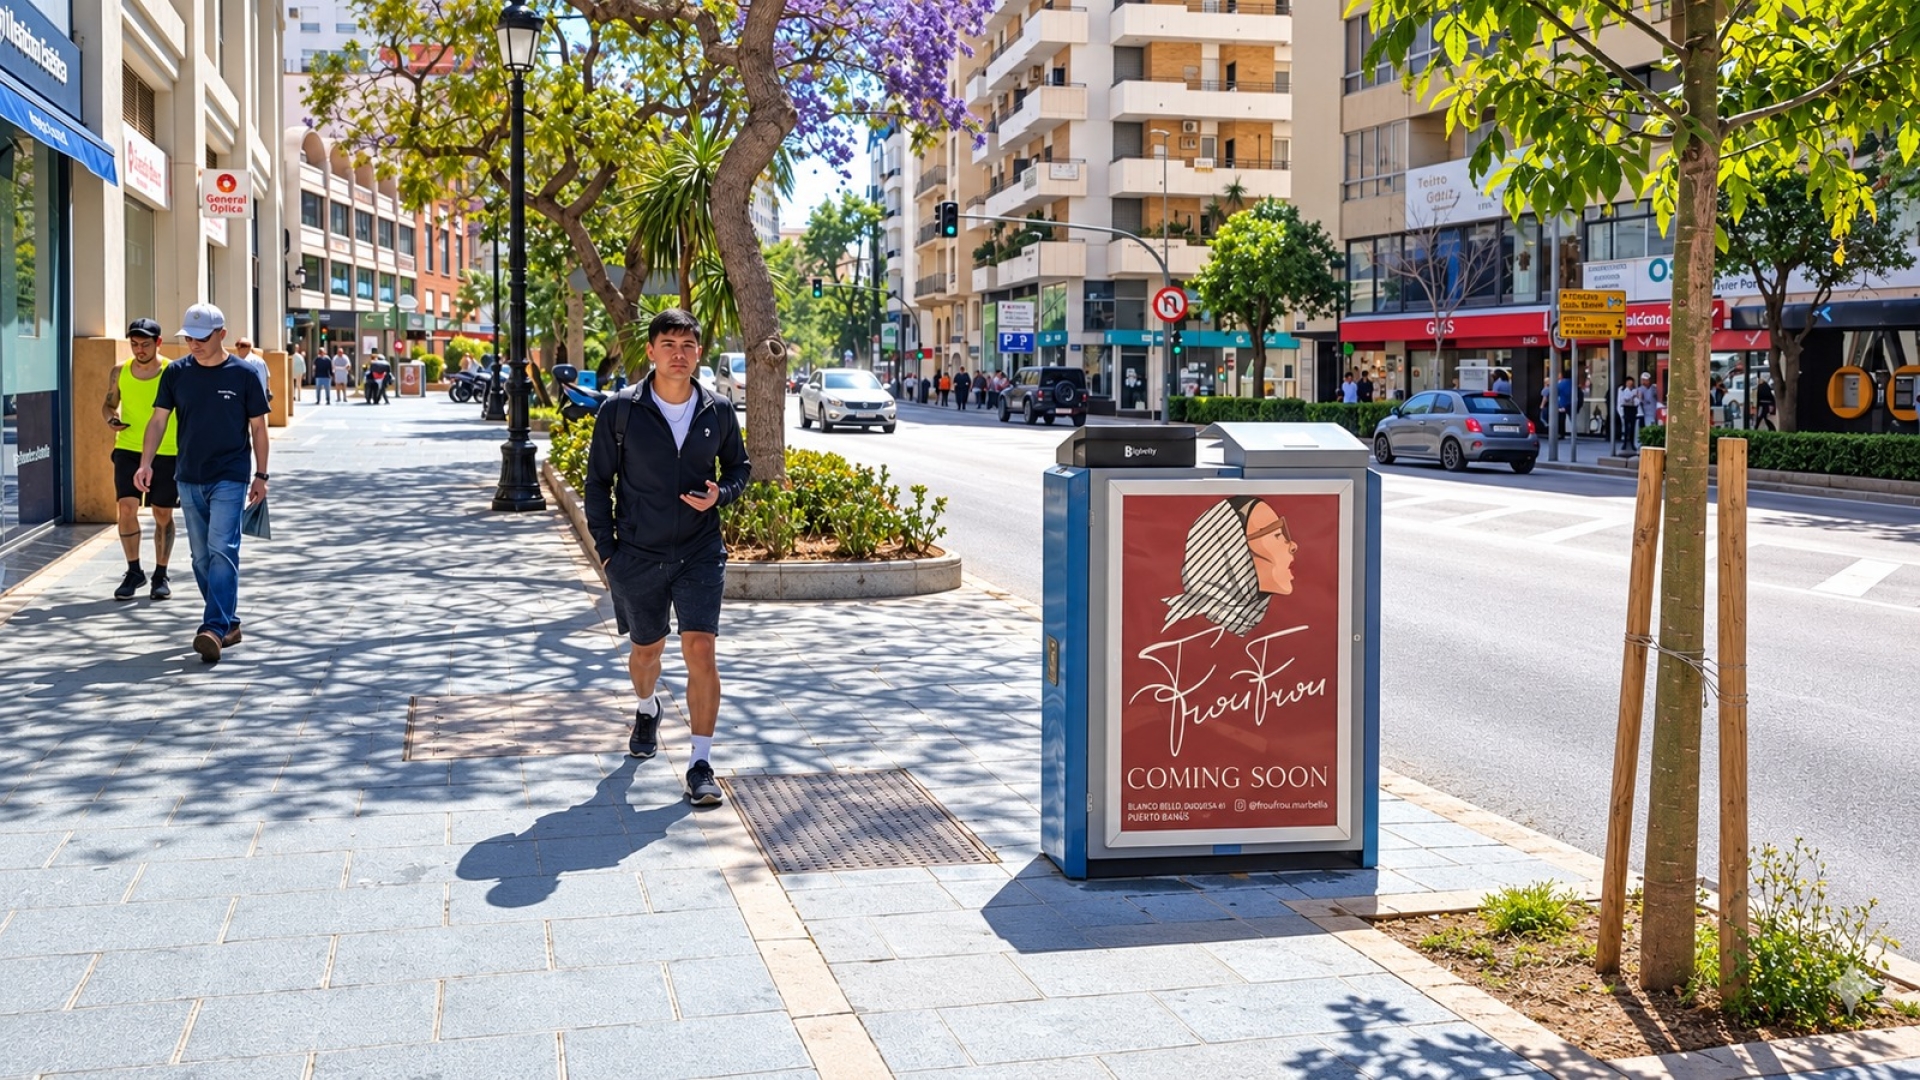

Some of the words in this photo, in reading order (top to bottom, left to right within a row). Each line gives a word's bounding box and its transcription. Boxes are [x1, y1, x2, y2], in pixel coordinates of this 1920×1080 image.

[206, 194, 247, 204] General
[1127, 767, 1240, 790] COMING
[1250, 766, 1328, 788] SOON
[1127, 802, 1158, 811] BLANCO
[1127, 813, 1160, 821] PUERTO
